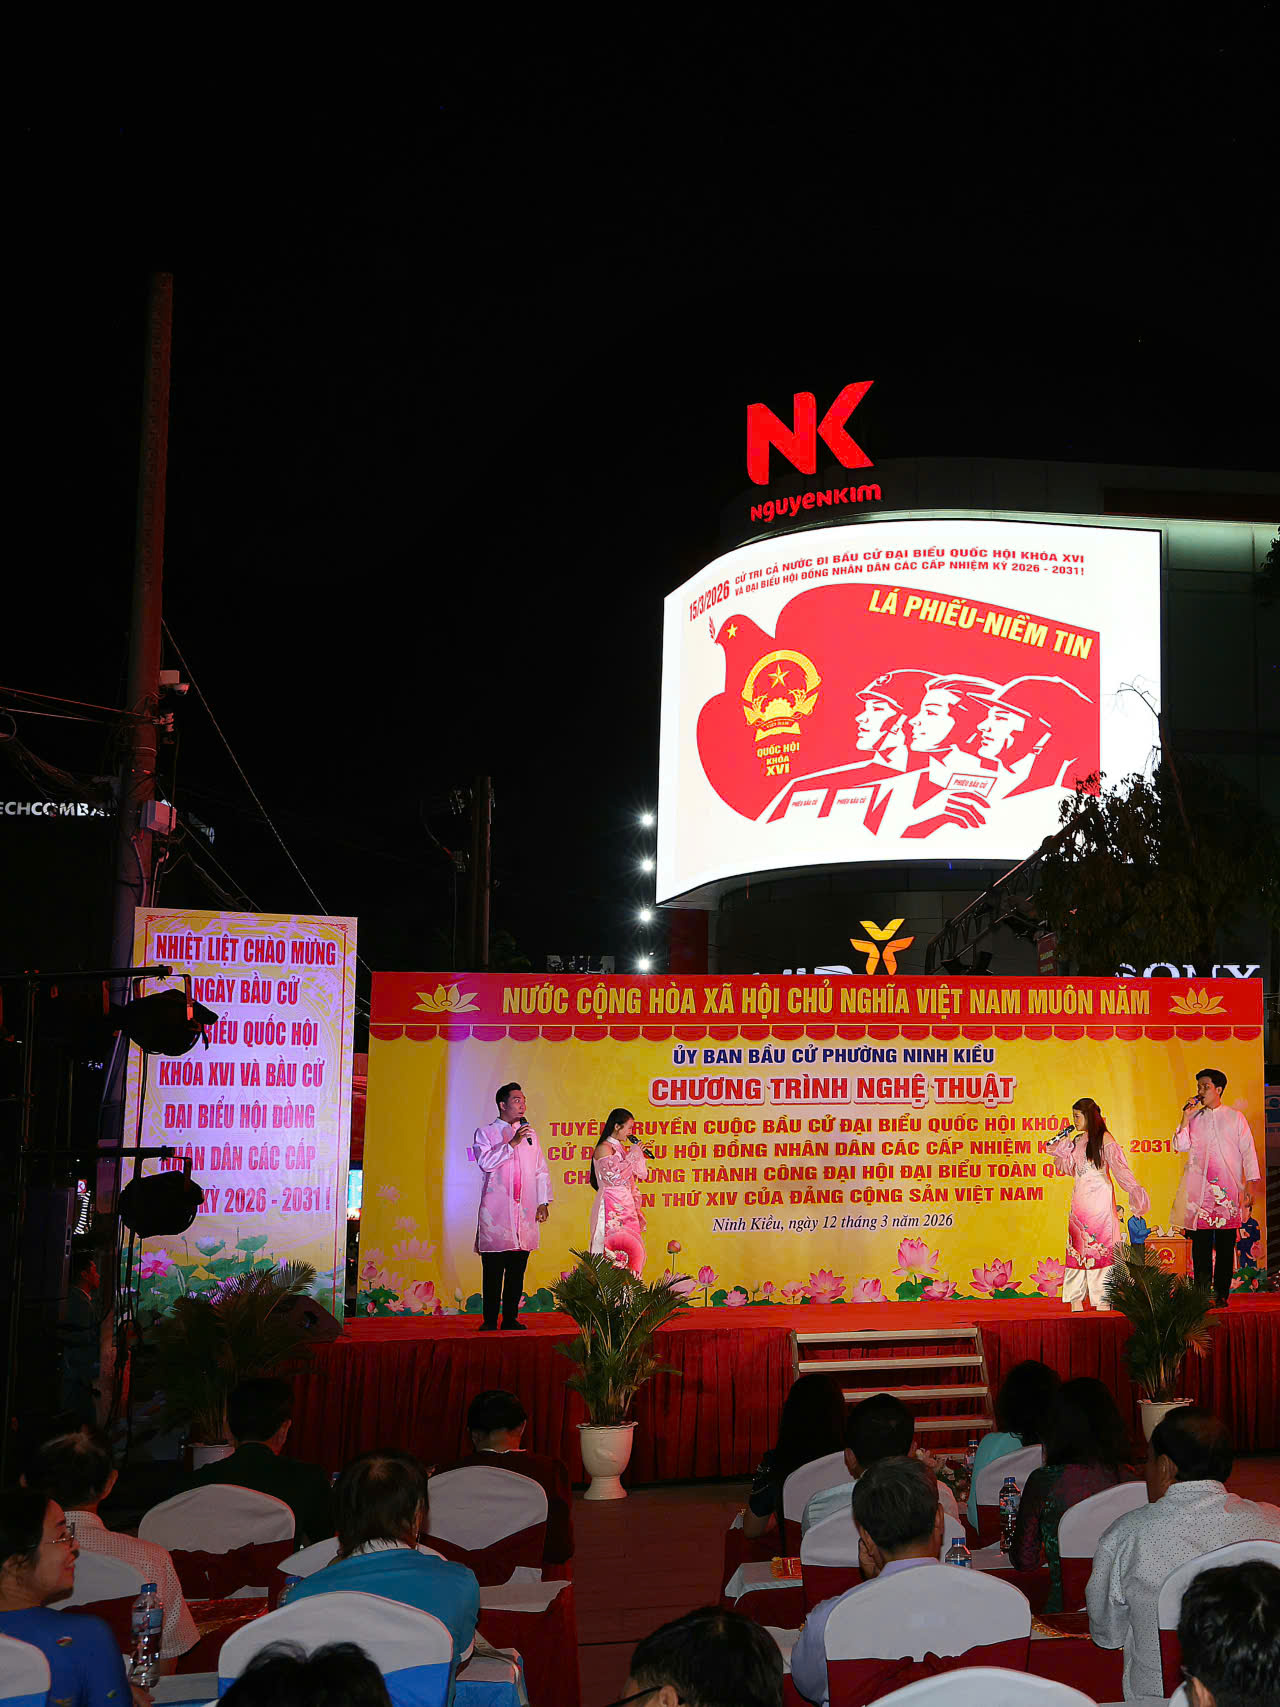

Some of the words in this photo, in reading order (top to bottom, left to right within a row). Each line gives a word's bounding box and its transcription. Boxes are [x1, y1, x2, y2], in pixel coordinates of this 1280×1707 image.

[747, 380, 874, 485] NK
[689, 580, 730, 621] 15/3/2026
[868, 588, 900, 615] LÁ
[1053, 630, 1093, 660] TIN
[757, 743, 781, 758] QUỐC
[783, 742, 800, 754] HỘI
[766, 755, 790, 766] KHÓA
[765, 764, 790, 776] XVI
[156, 932, 203, 963] NHIỆT
[207, 934, 239, 964] LIỆT
[243, 935, 286, 964] CHÀO
[291, 938, 336, 966] MỪNG
[194, 975, 235, 1003] NGÀY
[240, 971, 271, 1005] BẦU
[277, 975, 300, 1005] CỬ
[503, 983, 569, 1014] NƯỚC
[576, 981, 641, 1020] CỘNG
[649, 982, 696, 1013] HÒA
[703, 982, 733, 1013] XÃ
[741, 982, 780, 1019] HỘI
[787, 979, 833, 1013] CHỦ
[840, 984, 910, 1014] NGHĨA
[913, 986, 962, 1019] VIỆT
[970, 989, 1021, 1015] NAM
[1028, 985, 1093, 1015] MUÔN
[1100, 984, 1150, 1015] NĂM
[243, 1014, 286, 1048] QUỐC
[291, 1018, 318, 1050] HỘI
[673, 1044, 698, 1065] ỦY
[703, 1048, 742, 1065] BAN
[748, 1043, 788, 1064] BẦU
[791, 1043, 816, 1064] CỬ
[822, 1043, 897, 1063] PHƯỜNG
[903, 1049, 948, 1063] NINH
[953, 1044, 994, 1063] KIỀU
[159, 1054, 203, 1086] KHÓA
[208, 1062, 234, 1086] XVI
[240, 1056, 262, 1086] VÀ
[266, 1055, 297, 1087] BẦU
[302, 1059, 325, 1087] CỬ
[652, 1077, 762, 1101] CHƯƠNG
[770, 1074, 848, 1100] TRÌNH
[857, 1073, 926, 1106] NGHỆ
[934, 1073, 1014, 1105] THUẬT
[632, 1117, 696, 1135] RUYỀN
[704, 1117, 756, 1136] CUỘC
[763, 1114, 801, 1134] BẦU
[808, 1114, 836, 1133] CỬ
[840, 1118, 871, 1135] ĐẠI
[879, 1113, 921, 1132] BIỂU
[928, 1113, 978, 1132] QUỐC
[985, 1115, 1015, 1134] HỘI
[210, 1143, 242, 1171] DÂN
[248, 1143, 280, 1171] CÁC
[285, 1138, 316, 1170] CẤP
[548, 1142, 576, 1161] CỬ
[674, 1143, 706, 1161] HỘI
[713, 1139, 768, 1158] ĐỒNG
[774, 1140, 829, 1157] NHÂN
[927, 1136, 964, 1155] CẤP
[970, 1138, 1031, 1157] NHIỆM
[692, 1165, 757, 1182] THÀNH
[763, 1164, 817, 1181] CÔNG
[939, 1159, 981, 1178] BIỂU
[988, 1162, 1036, 1177] TOÀN
[224, 1188, 267, 1213] 2026
[662, 1190, 701, 1207] THỨ
[706, 1191, 738, 1206] XIV
[744, 1187, 784, 1205] CỦA
[790, 1186, 843, 1204] ĐẢNG
[850, 1187, 902, 1205] CỘNG
[909, 1184, 948, 1202] SẢN
[955, 1185, 994, 1204] VIỆT
[1000, 1187, 1043, 1201] NAM
[713, 1218, 746, 1231] Ninh
[750, 1215, 784, 1232] Kiều,
[788, 1218, 819, 1232] ngày
[822, 1216, 837, 1229] 12
[841, 1215, 877, 1231] tháng
[880, 1215, 888, 1227] 3
[892, 1215, 919, 1227] năm
[923, 1214, 953, 1227] 2026
